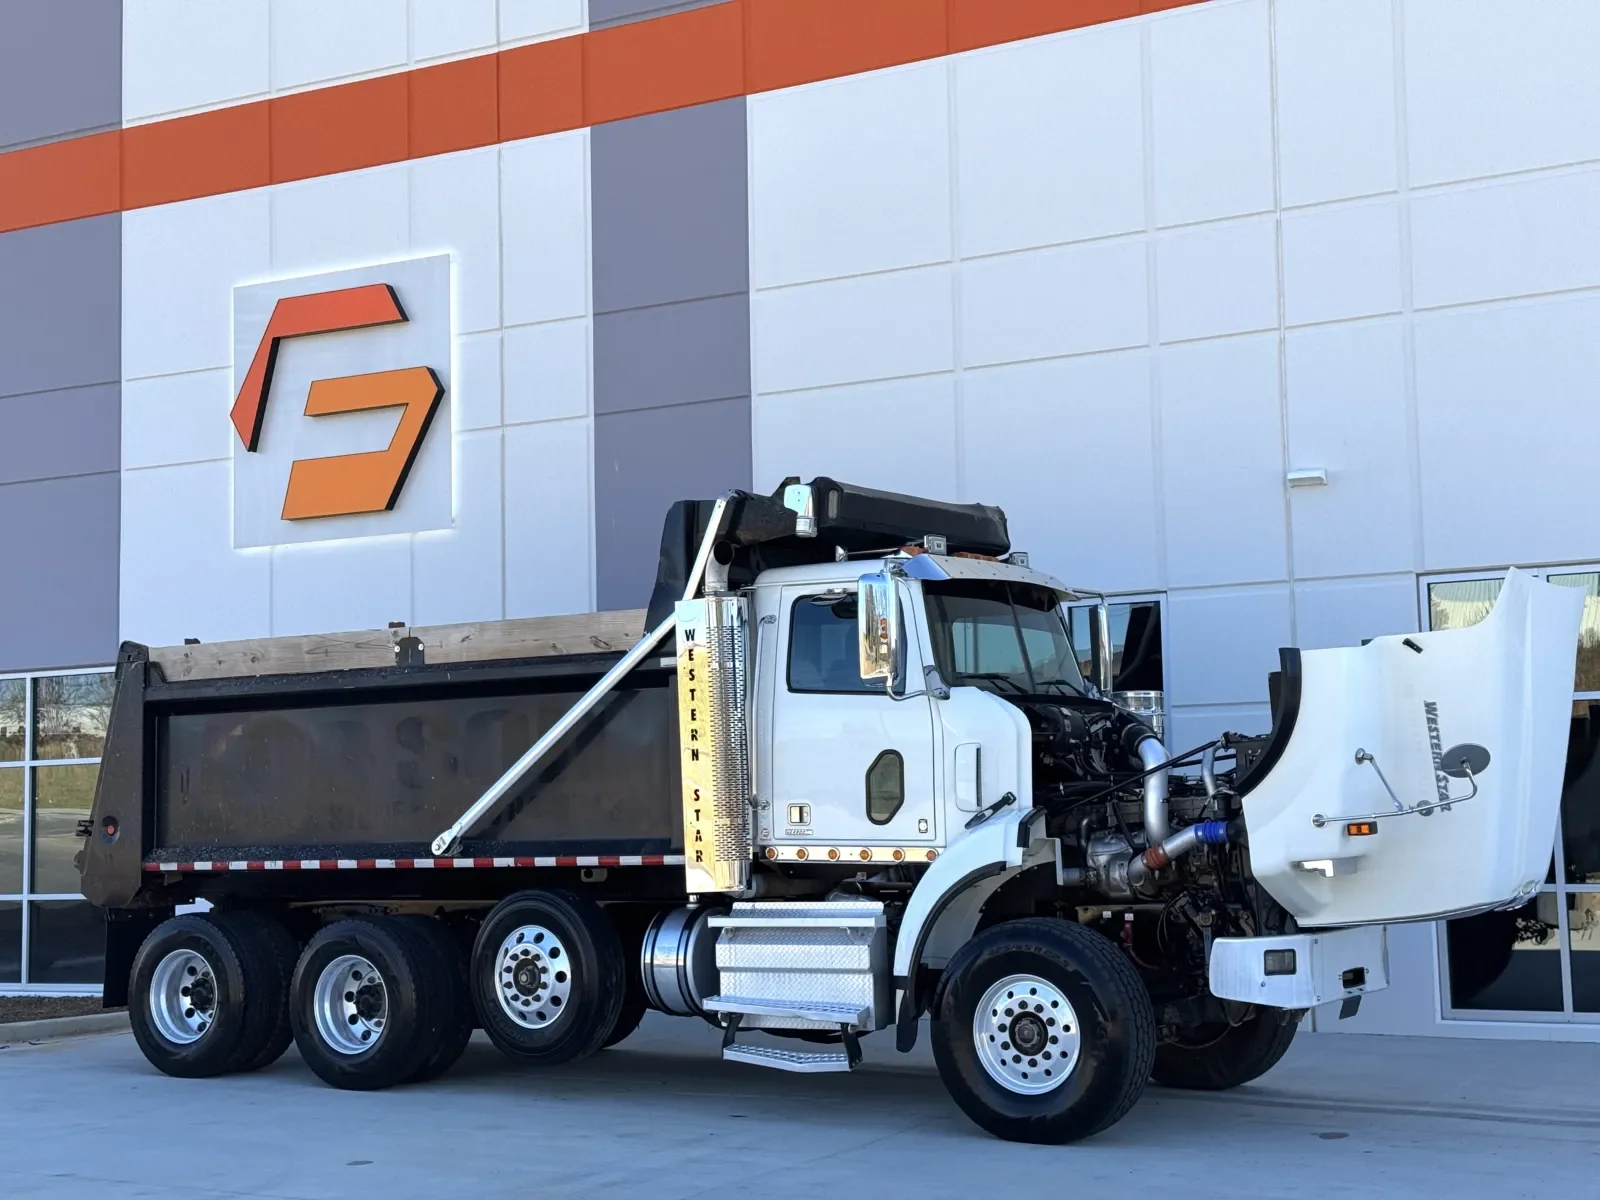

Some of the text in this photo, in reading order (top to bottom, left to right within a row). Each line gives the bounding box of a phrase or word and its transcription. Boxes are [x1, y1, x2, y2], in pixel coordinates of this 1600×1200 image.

[684, 629, 703, 863] WESTERN STAR
[1423, 700, 1452, 813] WESTERN STAR
